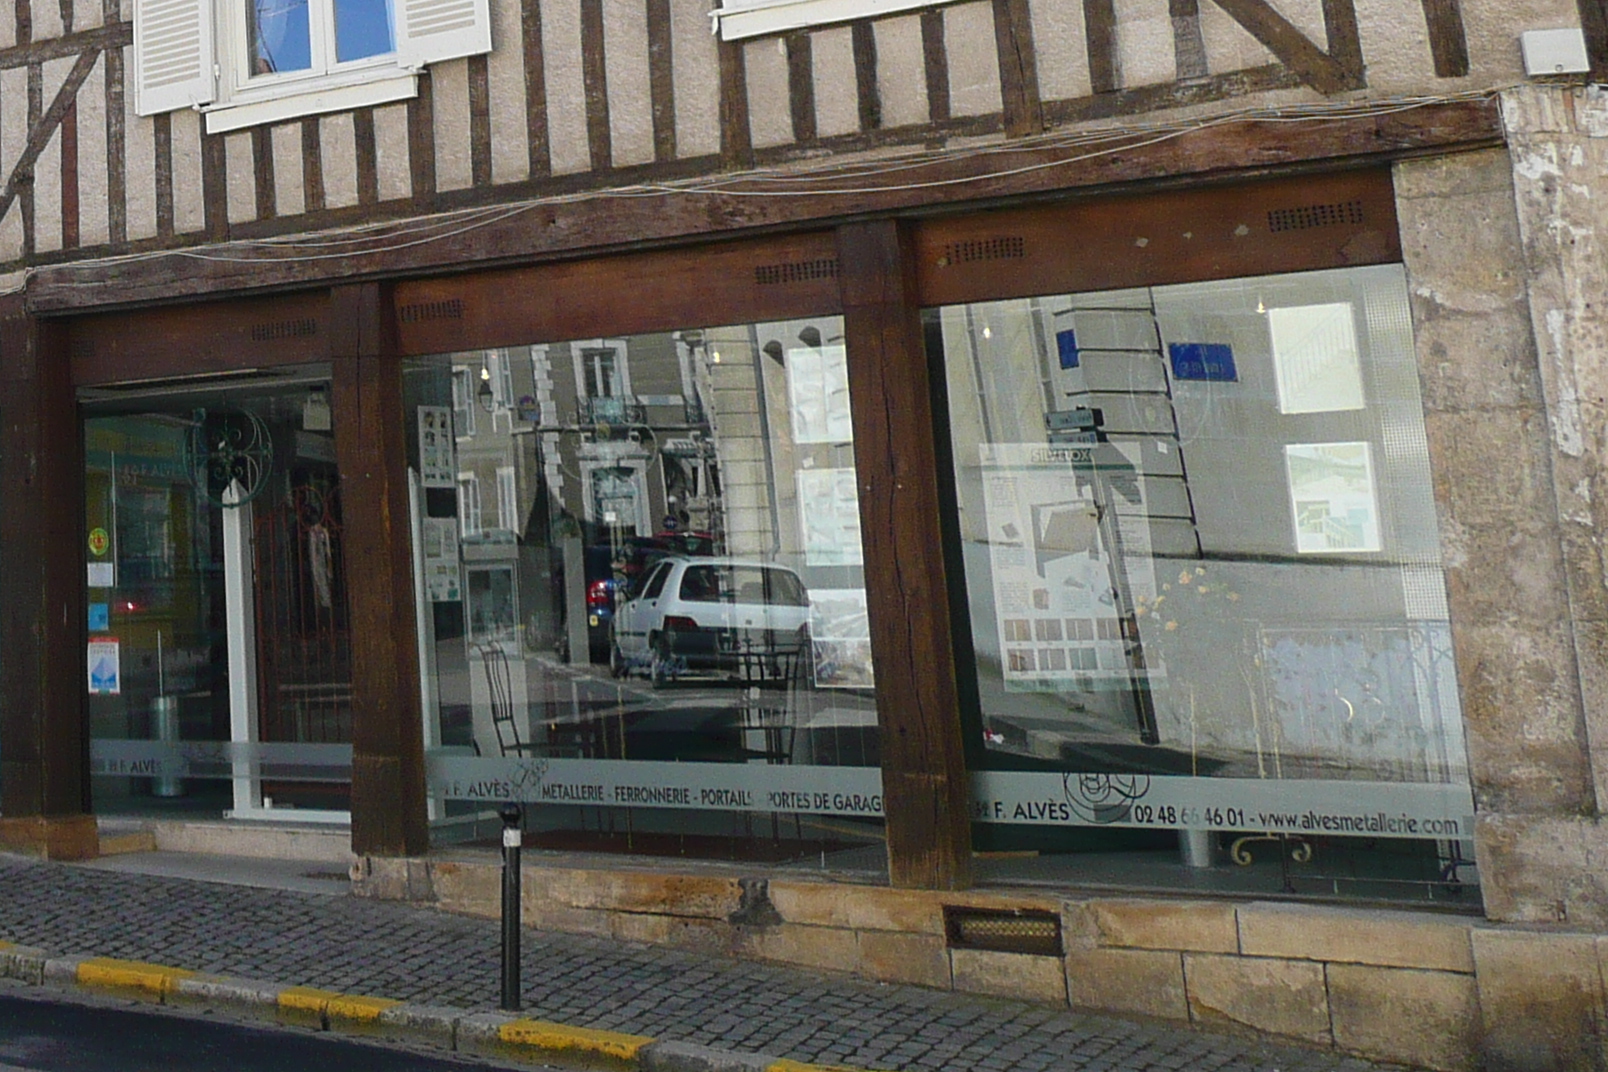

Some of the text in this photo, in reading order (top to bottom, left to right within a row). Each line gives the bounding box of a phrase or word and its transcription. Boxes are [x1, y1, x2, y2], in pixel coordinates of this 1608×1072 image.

[467, 778, 510, 798] ALVÈS
[615, 785, 691, 805] FERRONNERIE
[814, 793, 830, 810] DE
[1013, 798, 1070, 821] ALVÈS
[1134, 805, 1154, 823] 02
[1157, 806, 1177, 824] 48
[1204, 807, 1224, 825] 46
[1227, 808, 1245, 826] 01
[1259, 811, 1459, 835] www.alvesmetallerie.com
